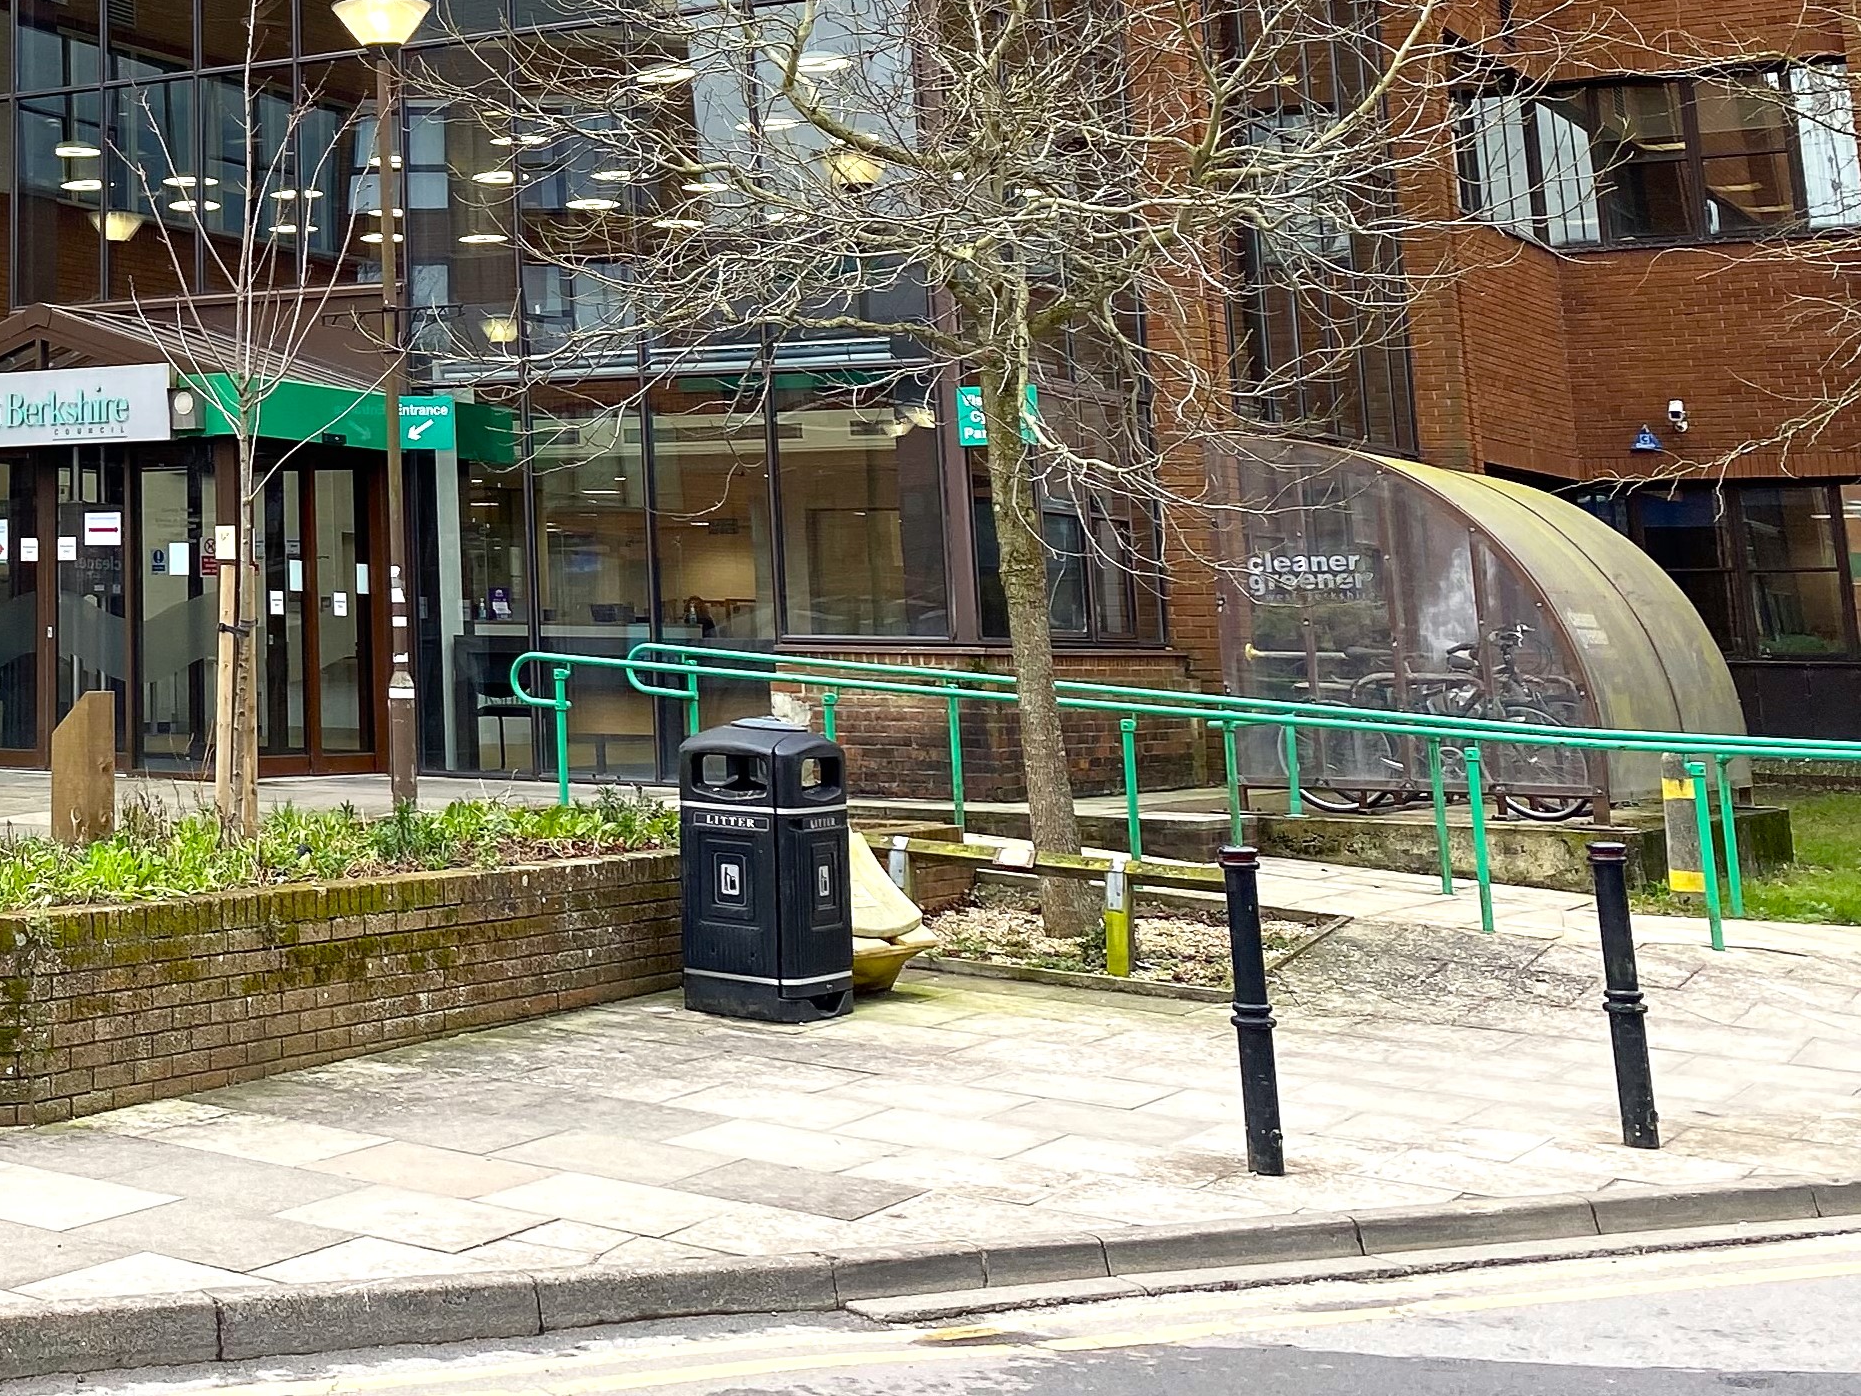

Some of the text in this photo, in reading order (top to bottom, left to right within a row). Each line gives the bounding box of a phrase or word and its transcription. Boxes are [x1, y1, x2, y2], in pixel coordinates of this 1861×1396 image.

[6, 385, 130, 428] Berkshire
[54, 427, 125, 436] COUNCIL
[1247, 552, 1360, 573] cleaner
[1248, 572, 1363, 596] greener
[706, 814, 755, 828] LITTER
[810, 817, 836, 829] LITTER
